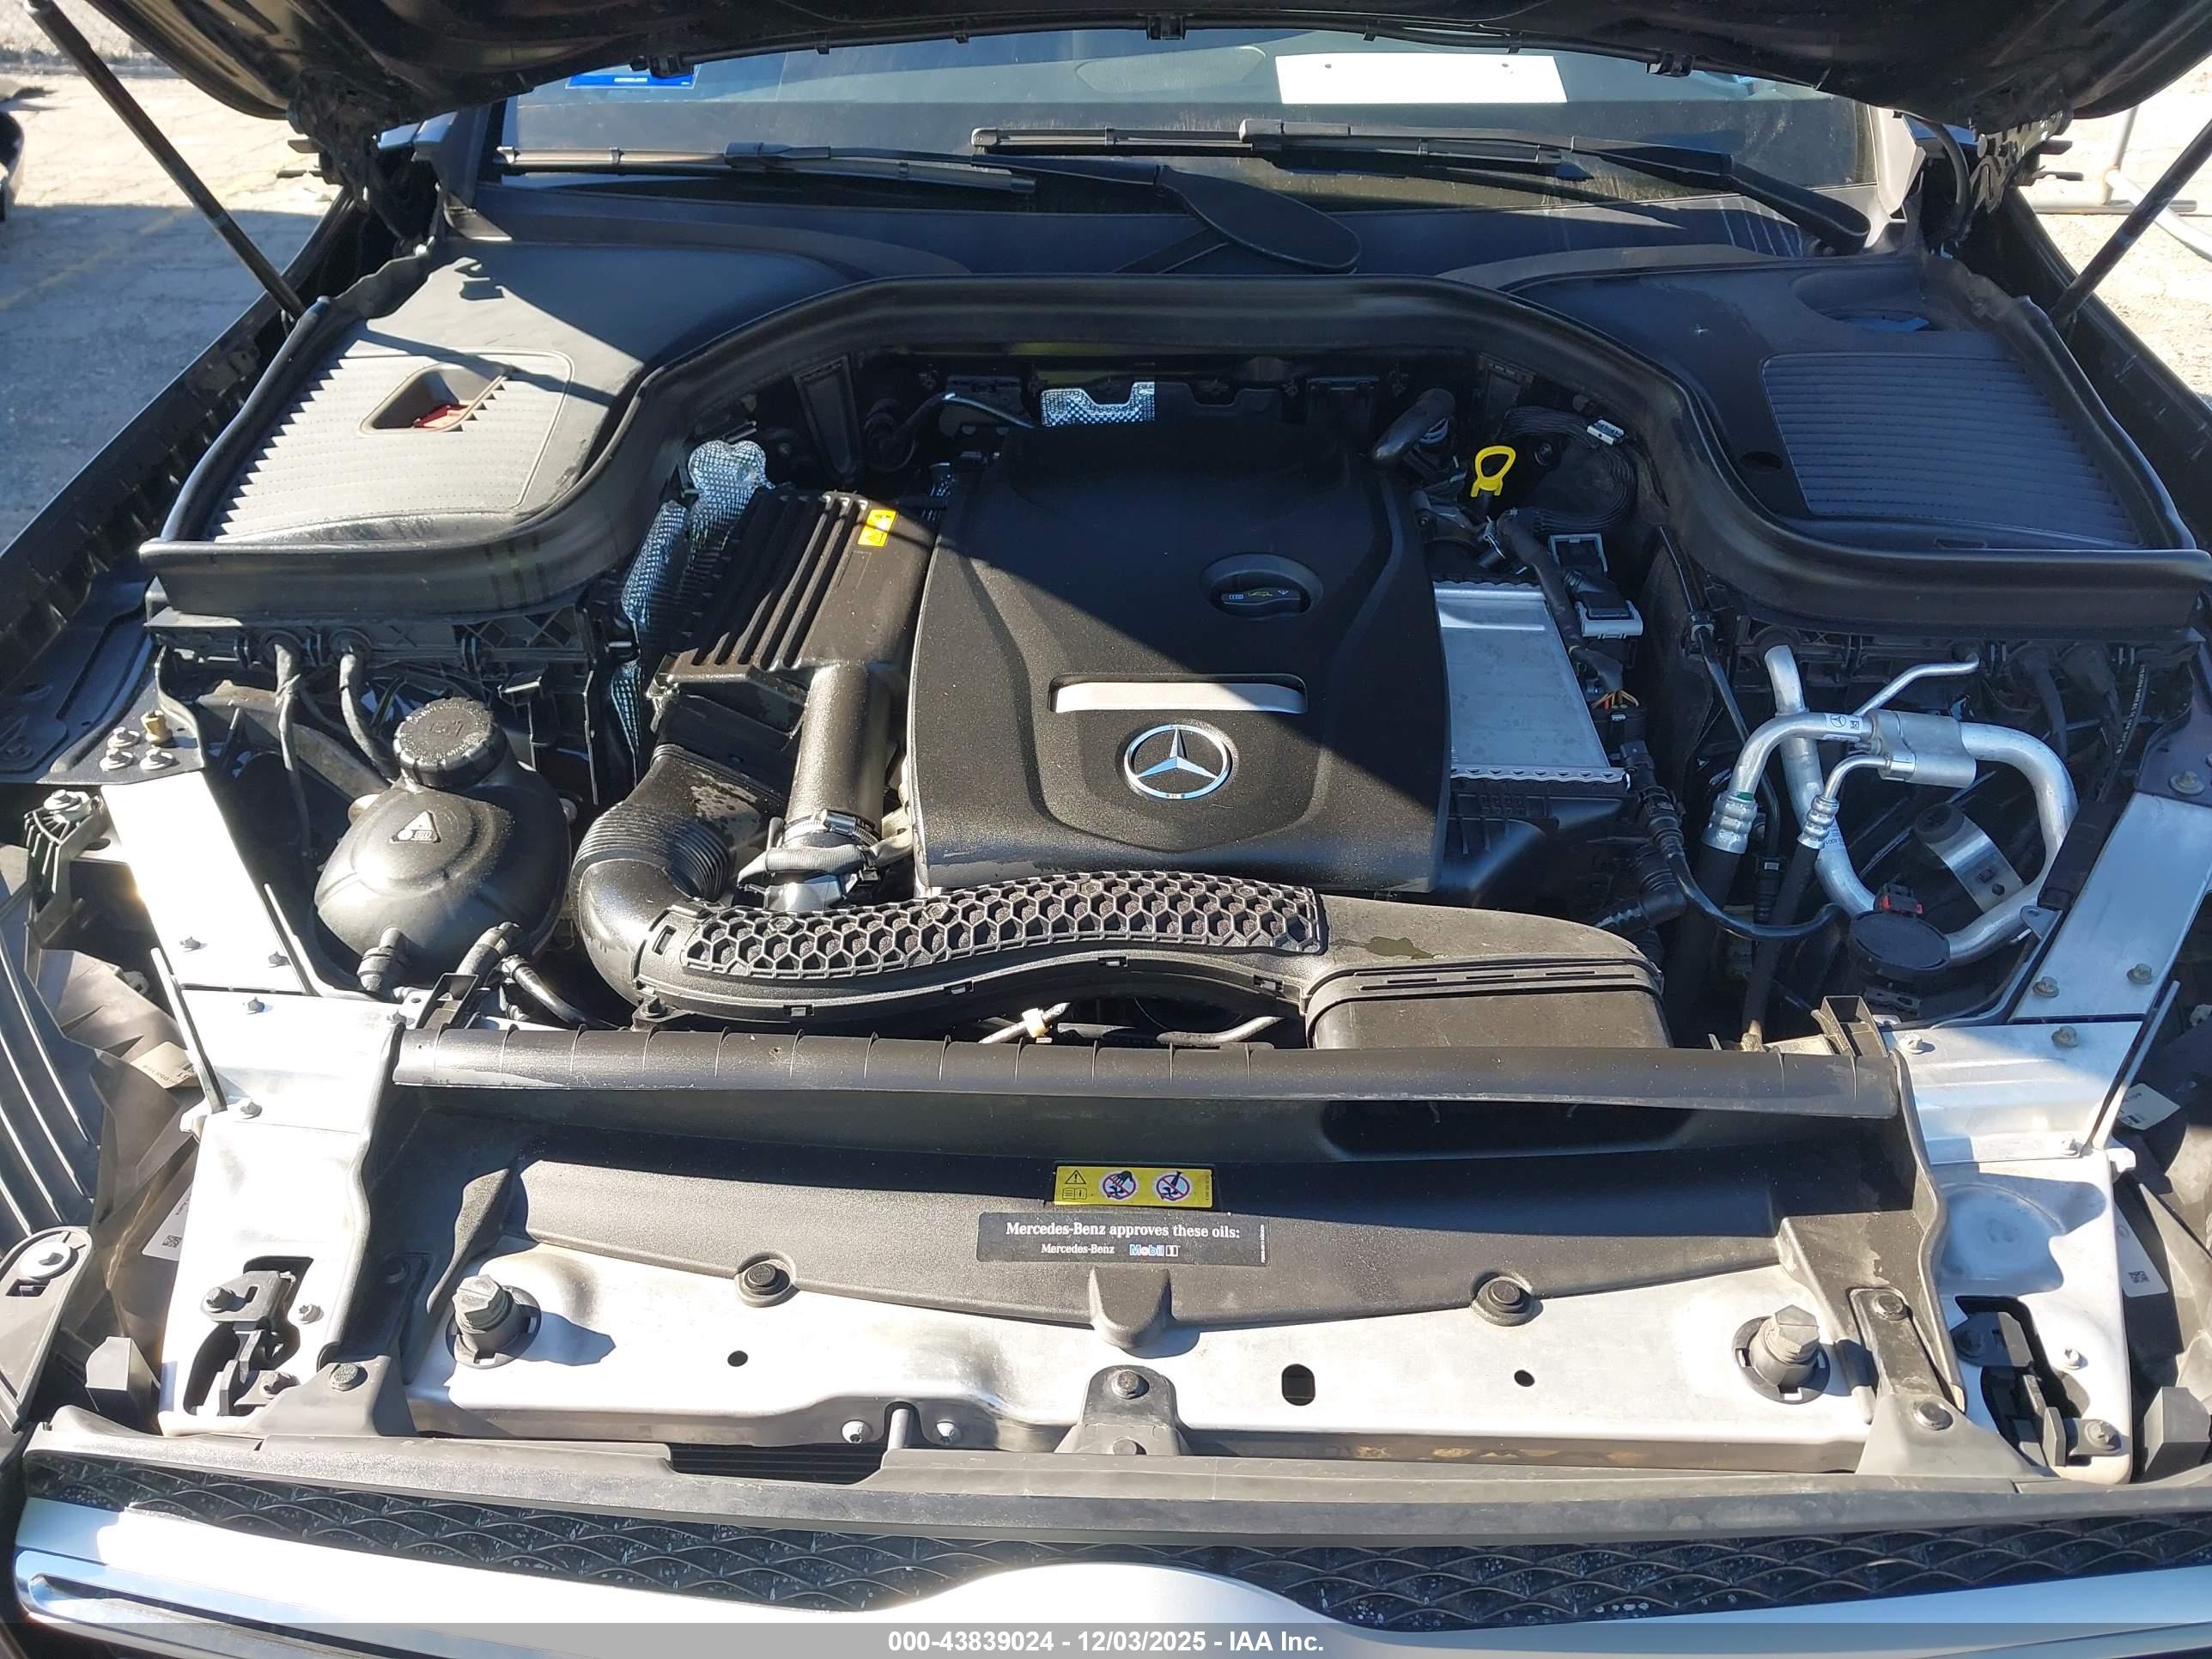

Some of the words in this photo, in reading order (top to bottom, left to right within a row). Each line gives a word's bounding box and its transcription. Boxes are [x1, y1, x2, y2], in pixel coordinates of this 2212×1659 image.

[1006, 1222, 1106, 1236] Mercedes-Benz
[1109, 1225, 1169, 1238] approves
[1173, 1224, 1209, 1237] these
[1212, 1224, 1241, 1238] oils:
[1041, 1243, 1115, 1255] Mercedes-Benz
[1129, 1243, 1164, 1257] Mobil
